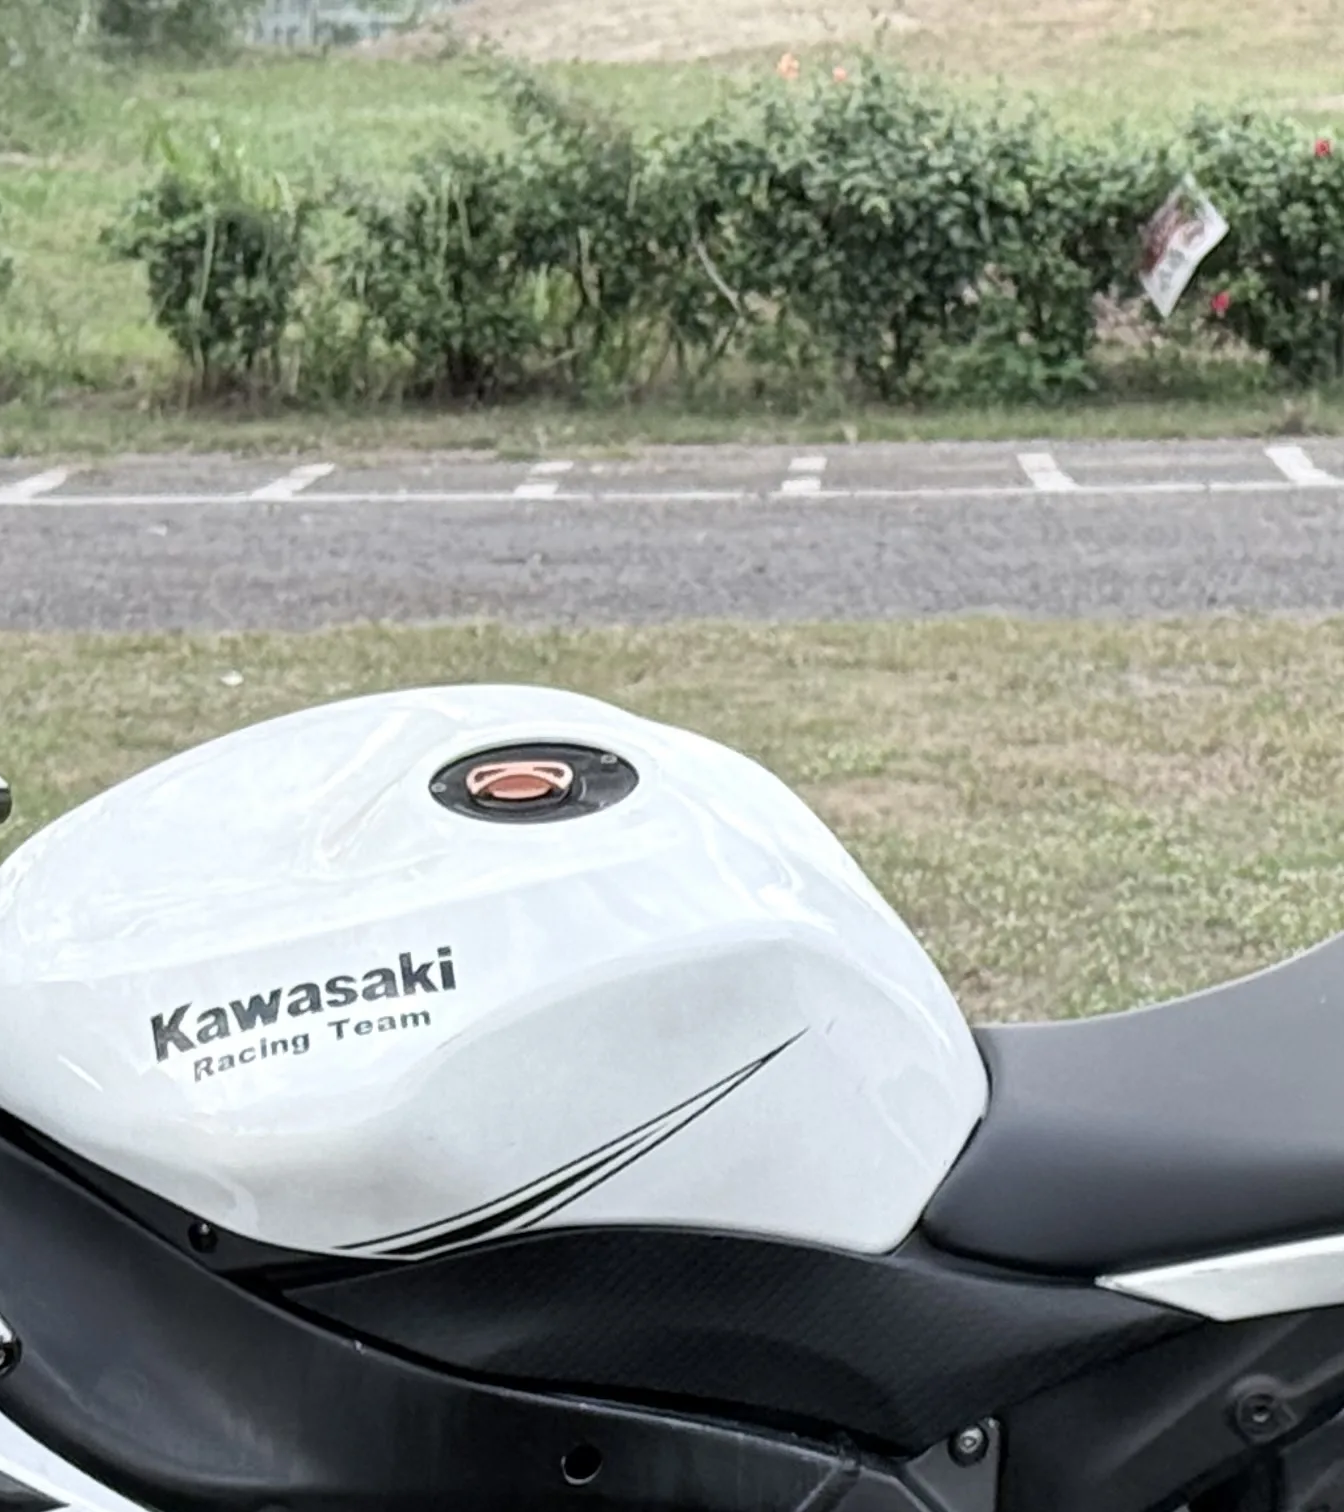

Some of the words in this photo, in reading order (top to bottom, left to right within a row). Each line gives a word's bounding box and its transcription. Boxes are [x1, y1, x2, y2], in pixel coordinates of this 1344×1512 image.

[150, 946, 457, 1064] Kawasaki
[193, 1031, 311, 1083] Racing
[327, 1008, 432, 1041] Team
